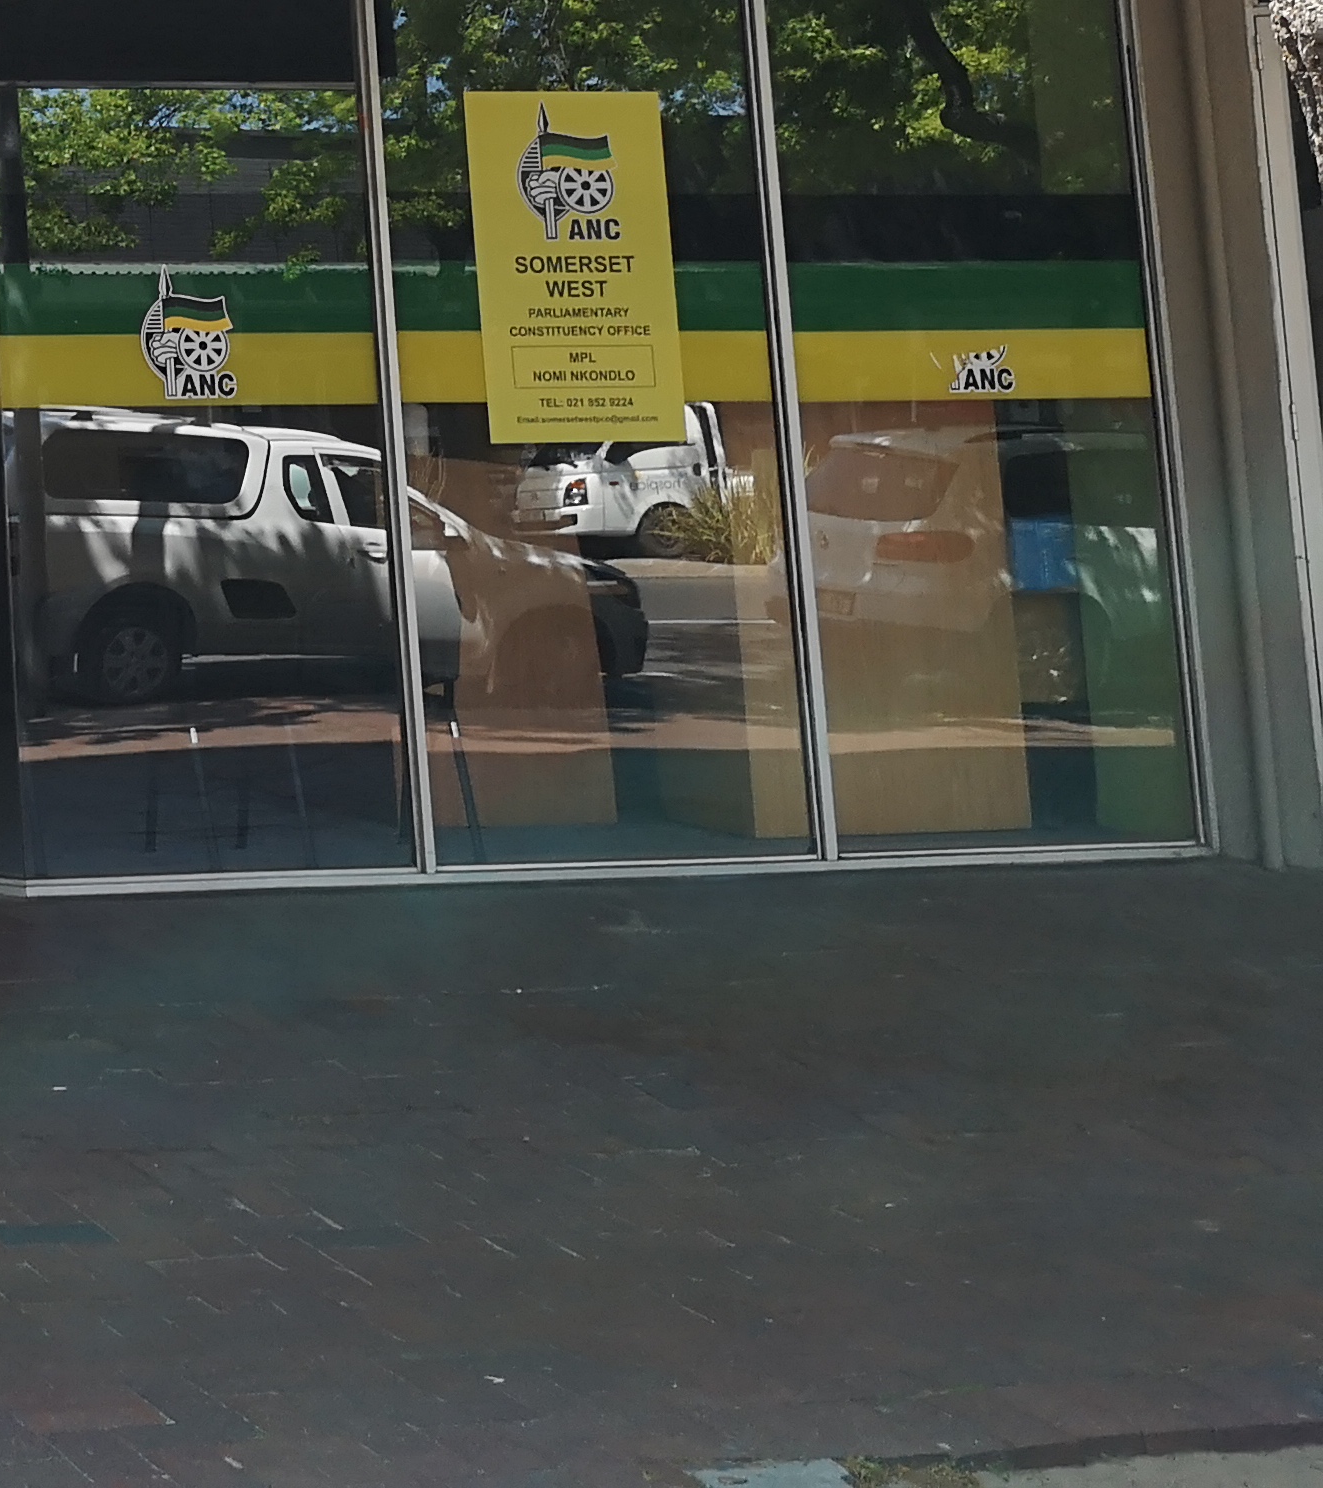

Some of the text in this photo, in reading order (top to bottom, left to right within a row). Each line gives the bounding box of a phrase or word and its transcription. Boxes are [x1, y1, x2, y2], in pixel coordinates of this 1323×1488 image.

[568, 218, 621, 241] ANC
[514, 255, 635, 274] SOMERSET
[545, 280, 609, 298] WEST
[528, 307, 630, 319] PARLIAMENTARY
[509, 324, 651, 338] CONSTITUENCY OFFICE
[569, 351, 597, 364] MPL
[532, 369, 636, 382] NOMI NKONDLO
[963, 368, 1014, 390] ANC
[181, 373, 236, 397] ANC
[566, 398, 585, 408] 021
